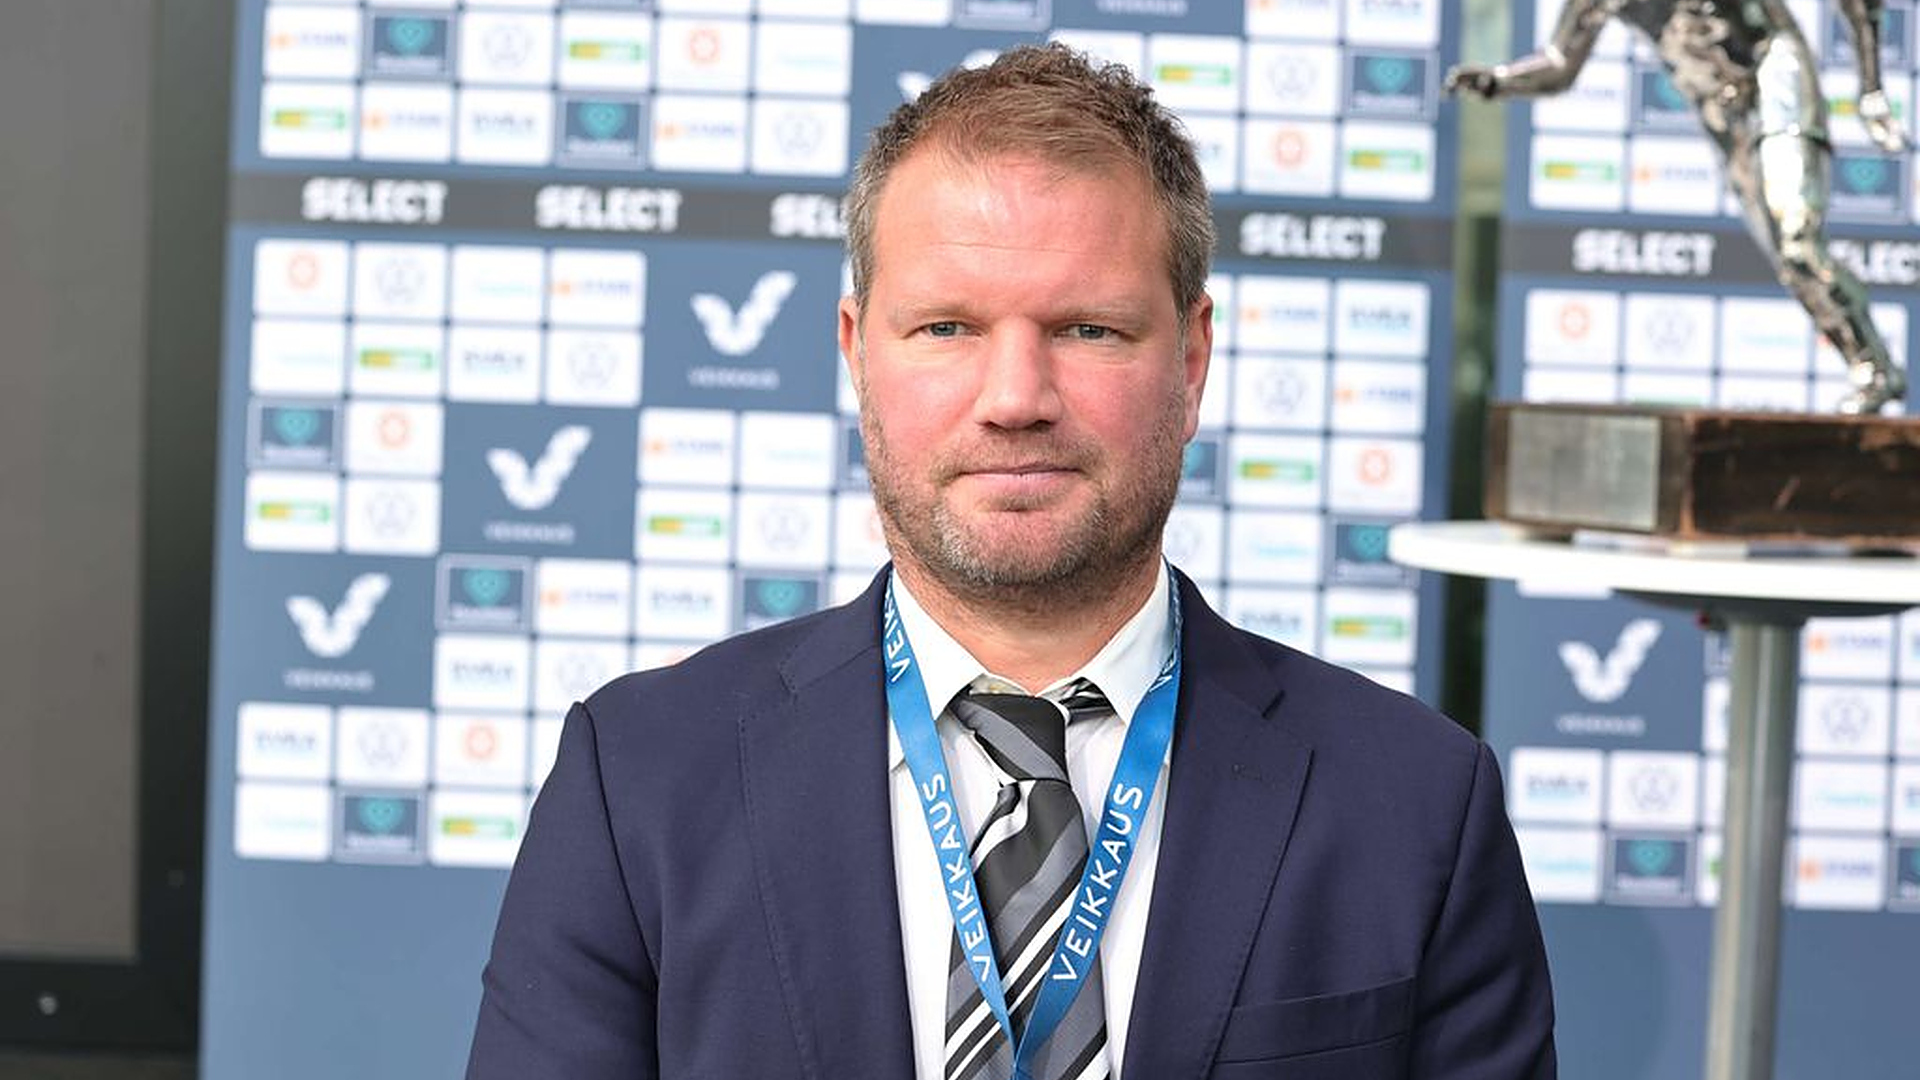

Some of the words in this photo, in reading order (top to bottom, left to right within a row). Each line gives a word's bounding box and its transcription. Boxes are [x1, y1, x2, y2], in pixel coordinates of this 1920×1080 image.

[303, 177, 447, 224] SELECT
[536, 185, 682, 233] SELECT
[769, 193, 850, 239] SEL
[1240, 213, 1385, 260] SELECT
[1573, 229, 1717, 276] SELECT
[922, 773, 991, 982] VEIKKAUS
[1052, 783, 1143, 980] VEIKKAUS
